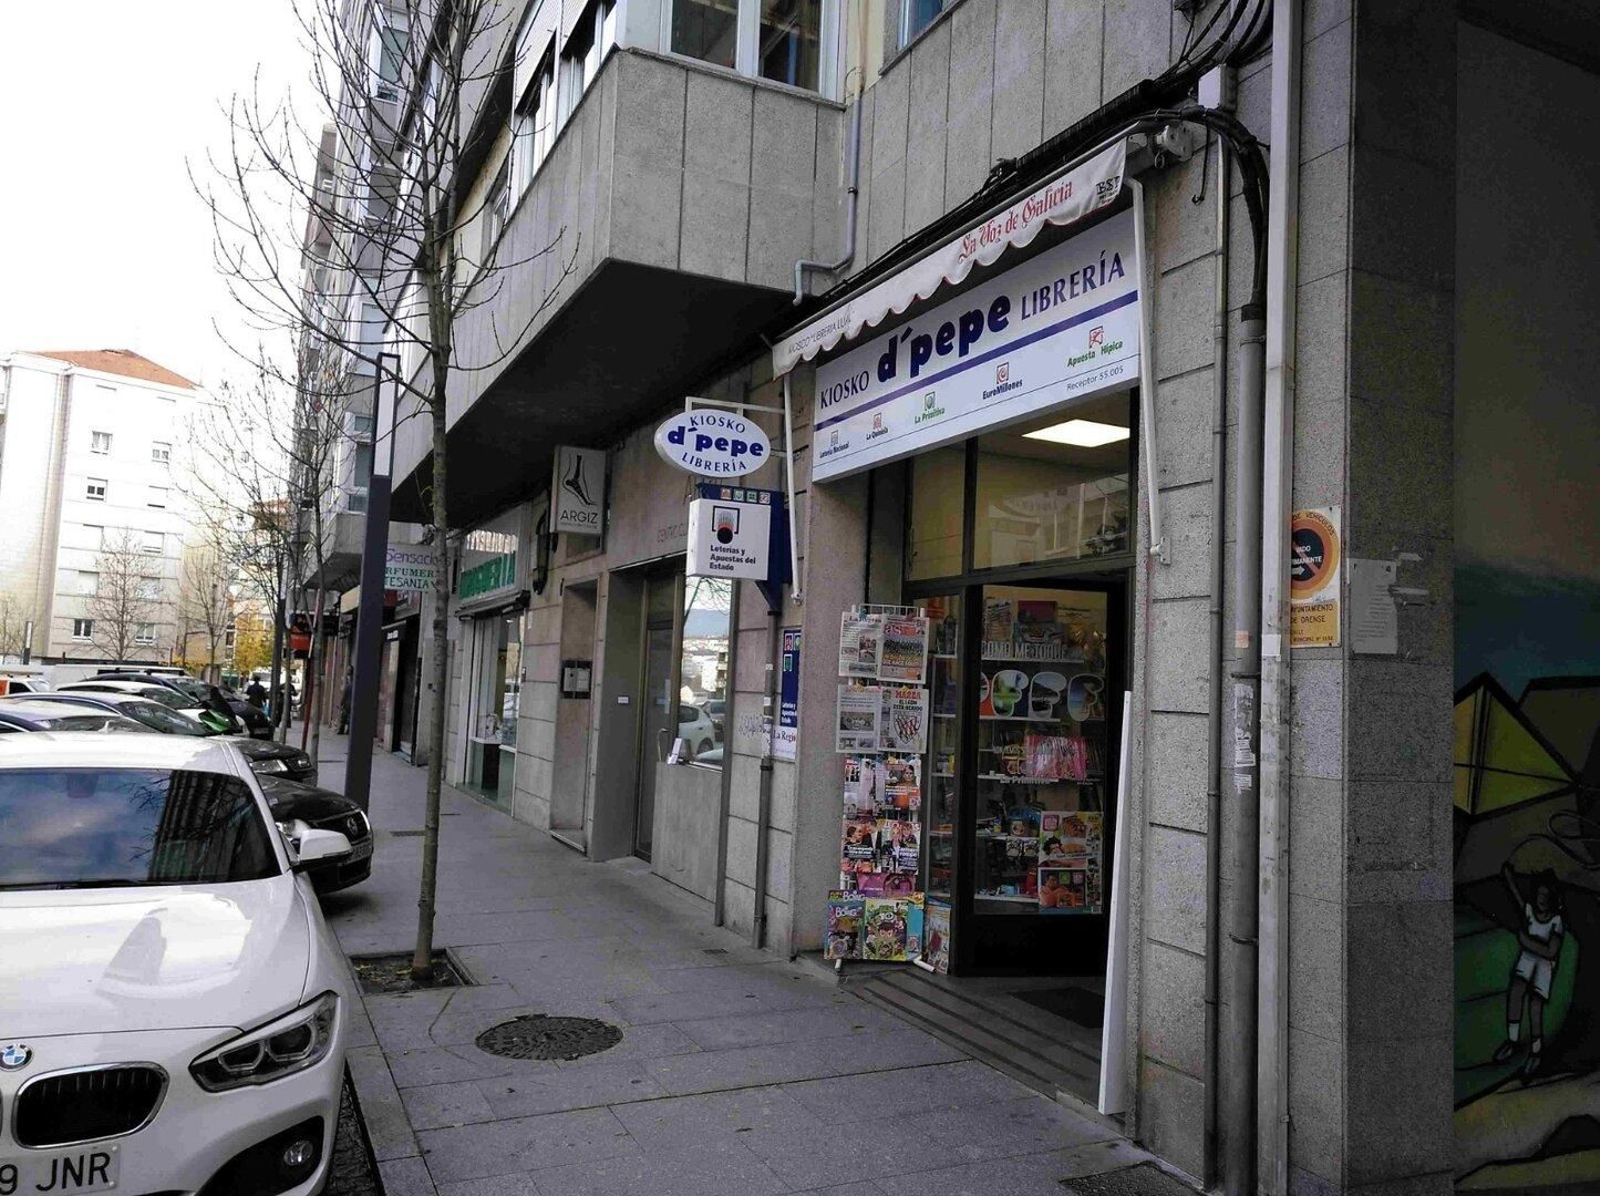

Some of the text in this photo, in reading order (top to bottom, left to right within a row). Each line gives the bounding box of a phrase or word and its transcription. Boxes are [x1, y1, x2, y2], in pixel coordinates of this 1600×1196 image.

[958, 234, 976, 264] La
[980, 219, 1001, 247] Voz
[1005, 209, 1019, 234] de
[1021, 181, 1073, 229] Galicia
[820, 370, 869, 409] KIOSKO
[1021, 249, 1125, 321] LIBRERÍA
[1067, 350, 1096, 368] Apuesta
[982, 378, 1023, 400] EuroMillones
[1066, 375, 1098, 391] Receptor
[914, 407, 945, 424] La Primitiva
[689, 415, 746, 434] KIOSKO
[681, 451, 747, 472] LIBRERÍA
[560, 509, 598, 524] ARGIZ
[710, 553, 743, 564] Apuestas
[740, 548, 746, 556] y
[709, 562, 734, 571] Estado
[1301, 615, 1326, 623] ORENSE
[36, 1152, 110, 1192] JNR
